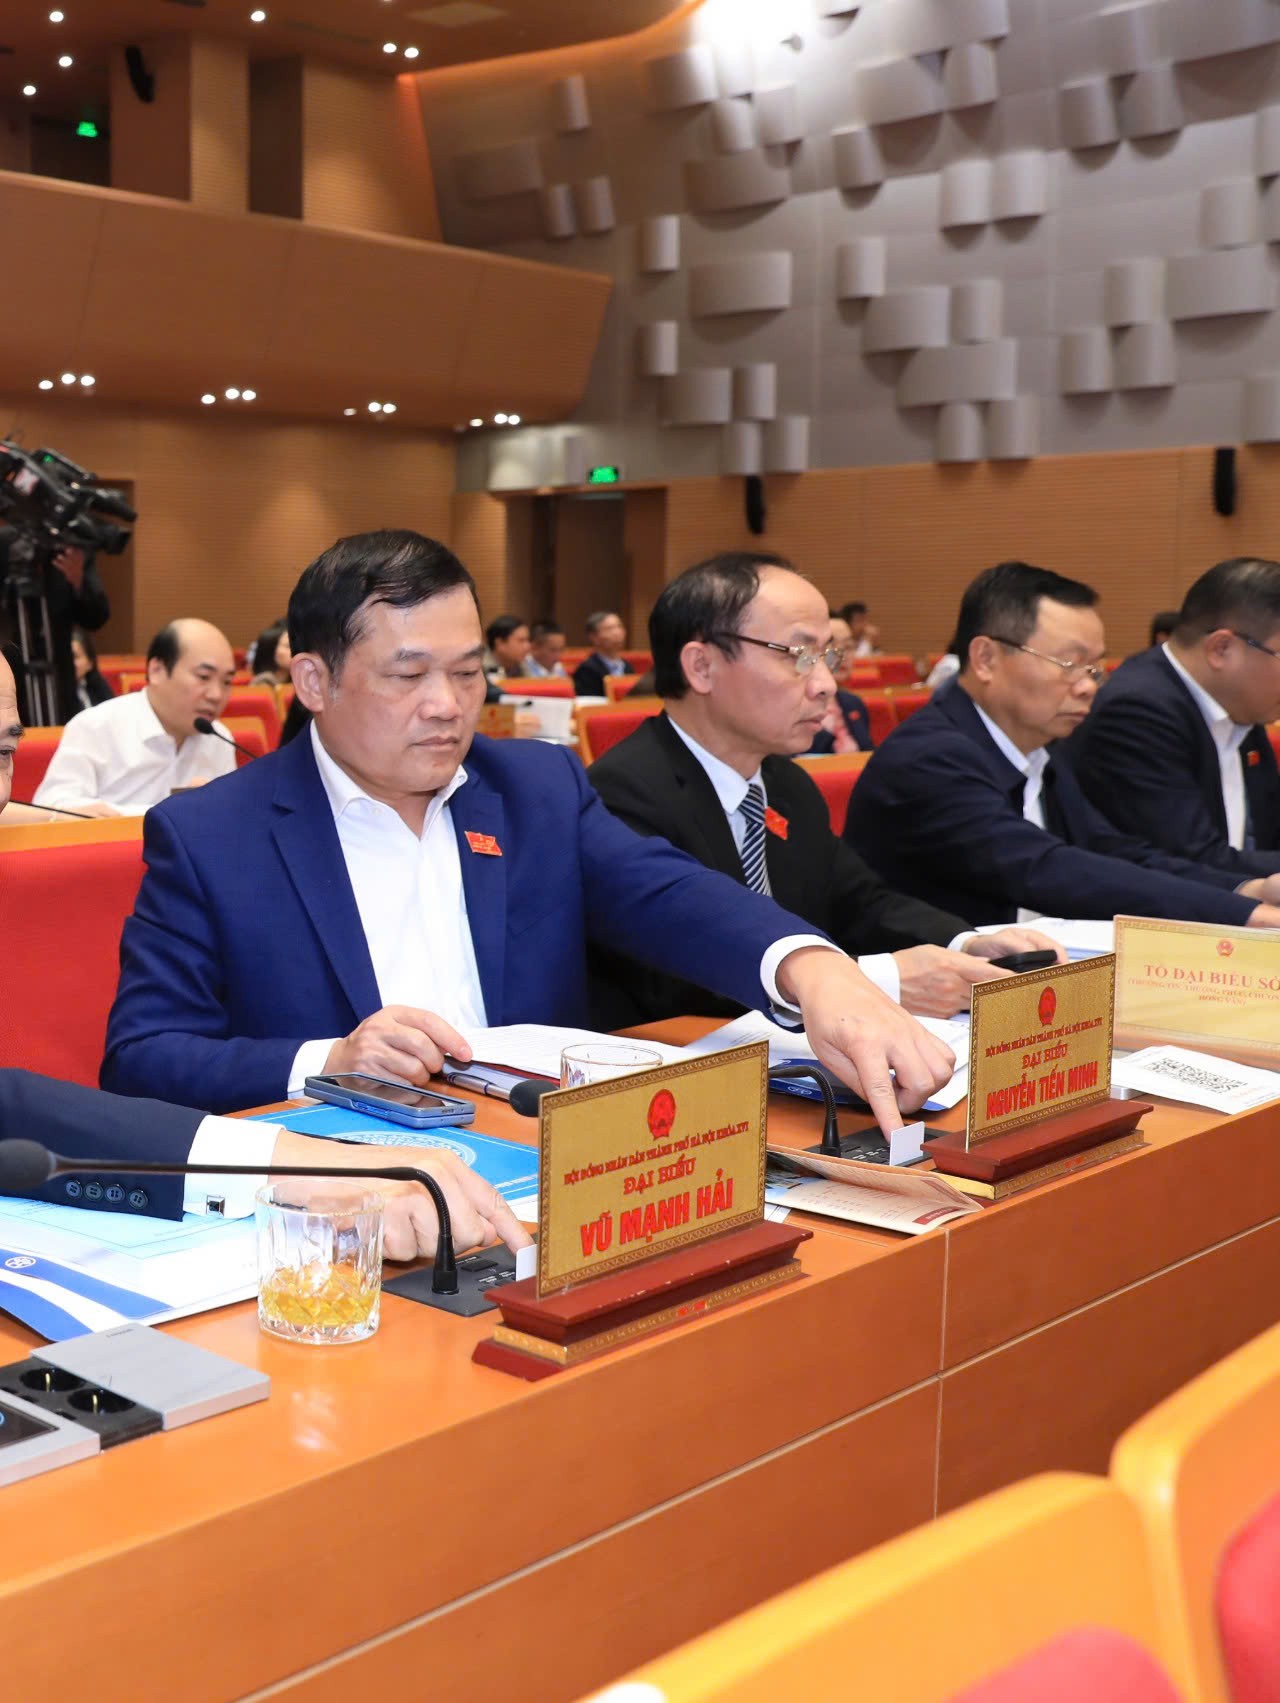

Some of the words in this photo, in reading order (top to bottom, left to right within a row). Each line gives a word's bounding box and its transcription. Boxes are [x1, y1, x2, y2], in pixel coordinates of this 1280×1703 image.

[1173, 967, 1203, 984] ĐẠI
[1022, 1051, 1041, 1069] ĐẠI
[1044, 1040, 1068, 1063] BIỂU
[986, 1072, 1036, 1120] NGUYỄN
[1039, 1064, 1065, 1103] TIẾN
[1068, 1061, 1098, 1094] MINH
[564, 1167, 580, 1186] HỘI
[581, 1163, 604, 1182] ĐỒNG
[605, 1156, 627, 1174] NHÂN
[629, 1151, 646, 1167] DÂN
[646, 1145, 672, 1161] THÀNH
[674, 1136, 689, 1154] PHỐ
[690, 1134, 702, 1148] HÀ
[702, 1129, 715, 1146] NỘI
[624, 1171, 654, 1196] ĐẠI
[658, 1153, 696, 1185] BIỂU
[581, 1210, 613, 1257] VŨ
[620, 1192, 690, 1243] MẠNH
[697, 1168, 734, 1219] HẢI
